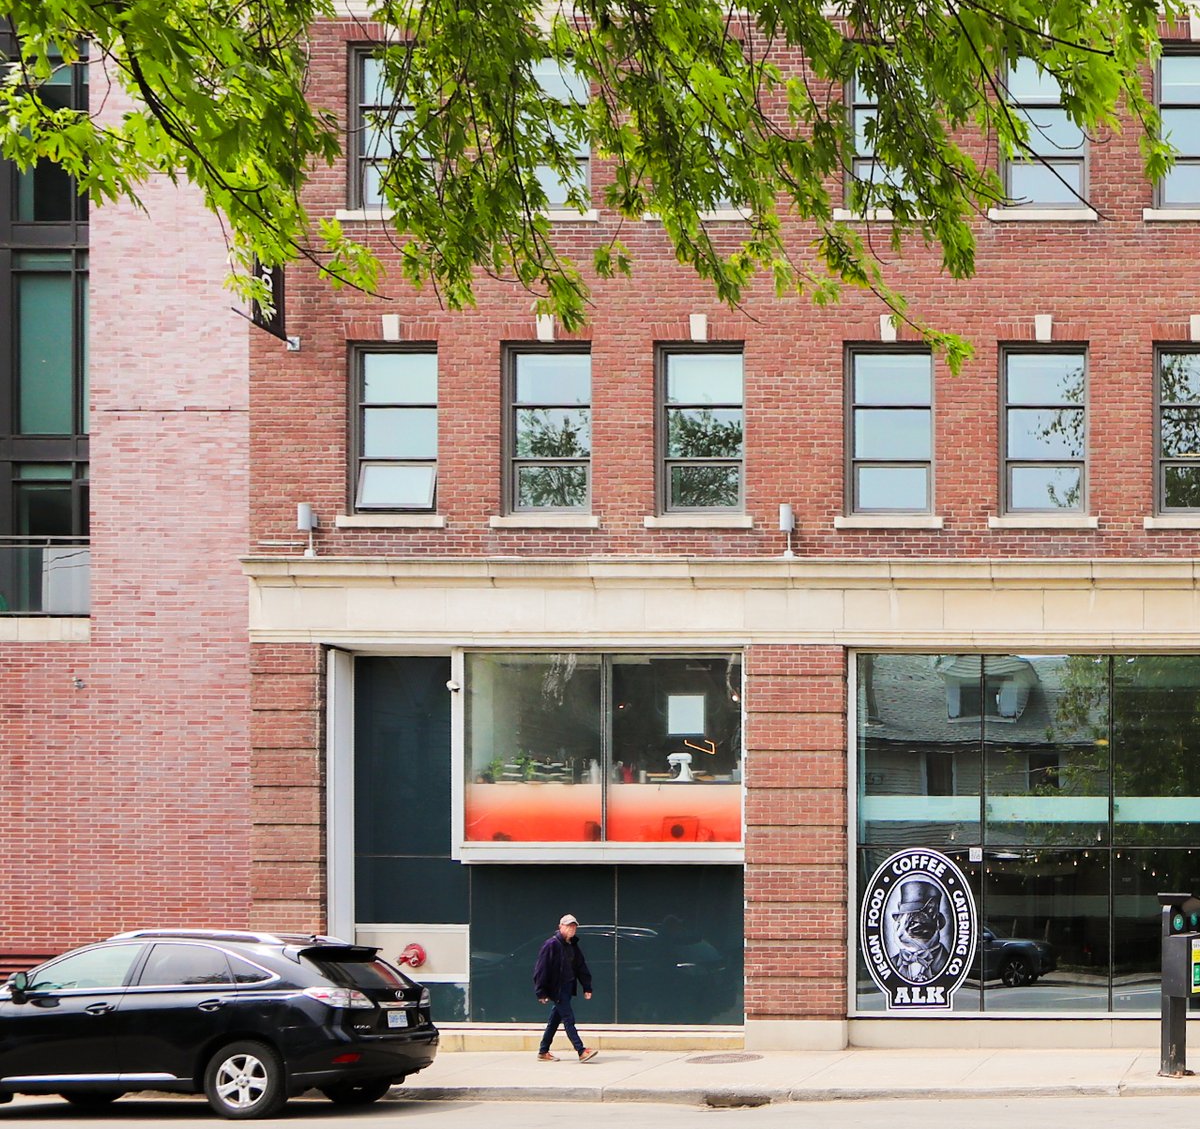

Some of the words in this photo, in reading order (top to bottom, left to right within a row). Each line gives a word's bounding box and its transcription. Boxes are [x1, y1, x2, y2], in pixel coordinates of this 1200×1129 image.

[892, 855, 947, 878] COFFEE
[867, 888, 885, 928] FOOD
[952, 890, 970, 955] CATERING
[868, 934, 892, 980] VEGAN
[945, 957, 963, 976] CO.
[894, 986, 945, 1003] ALK
